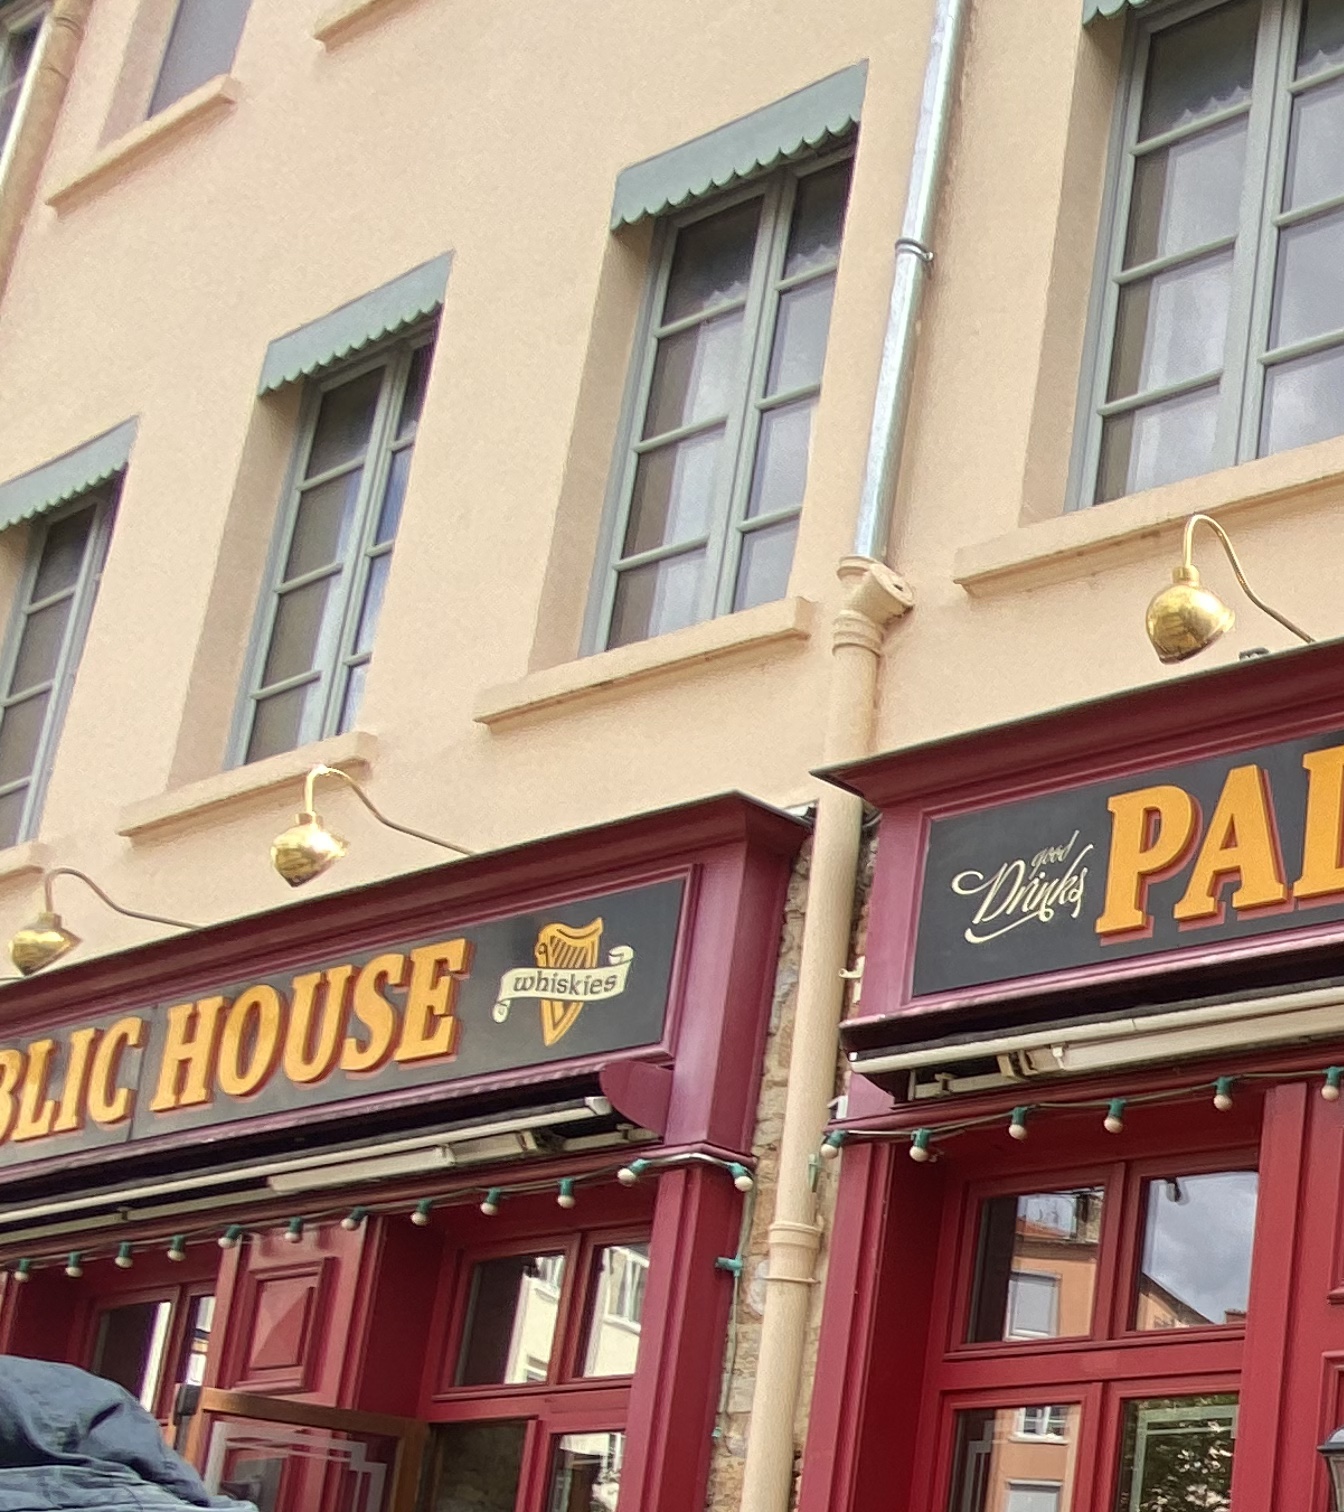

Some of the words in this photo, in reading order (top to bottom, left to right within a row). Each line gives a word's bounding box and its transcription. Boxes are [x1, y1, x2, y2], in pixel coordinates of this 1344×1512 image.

[1028, 829, 1080, 880] good
[951, 844, 1094, 944] Drinks
[513, 970, 618, 996] whiskies
[150, 938, 472, 1112] HOUSE
